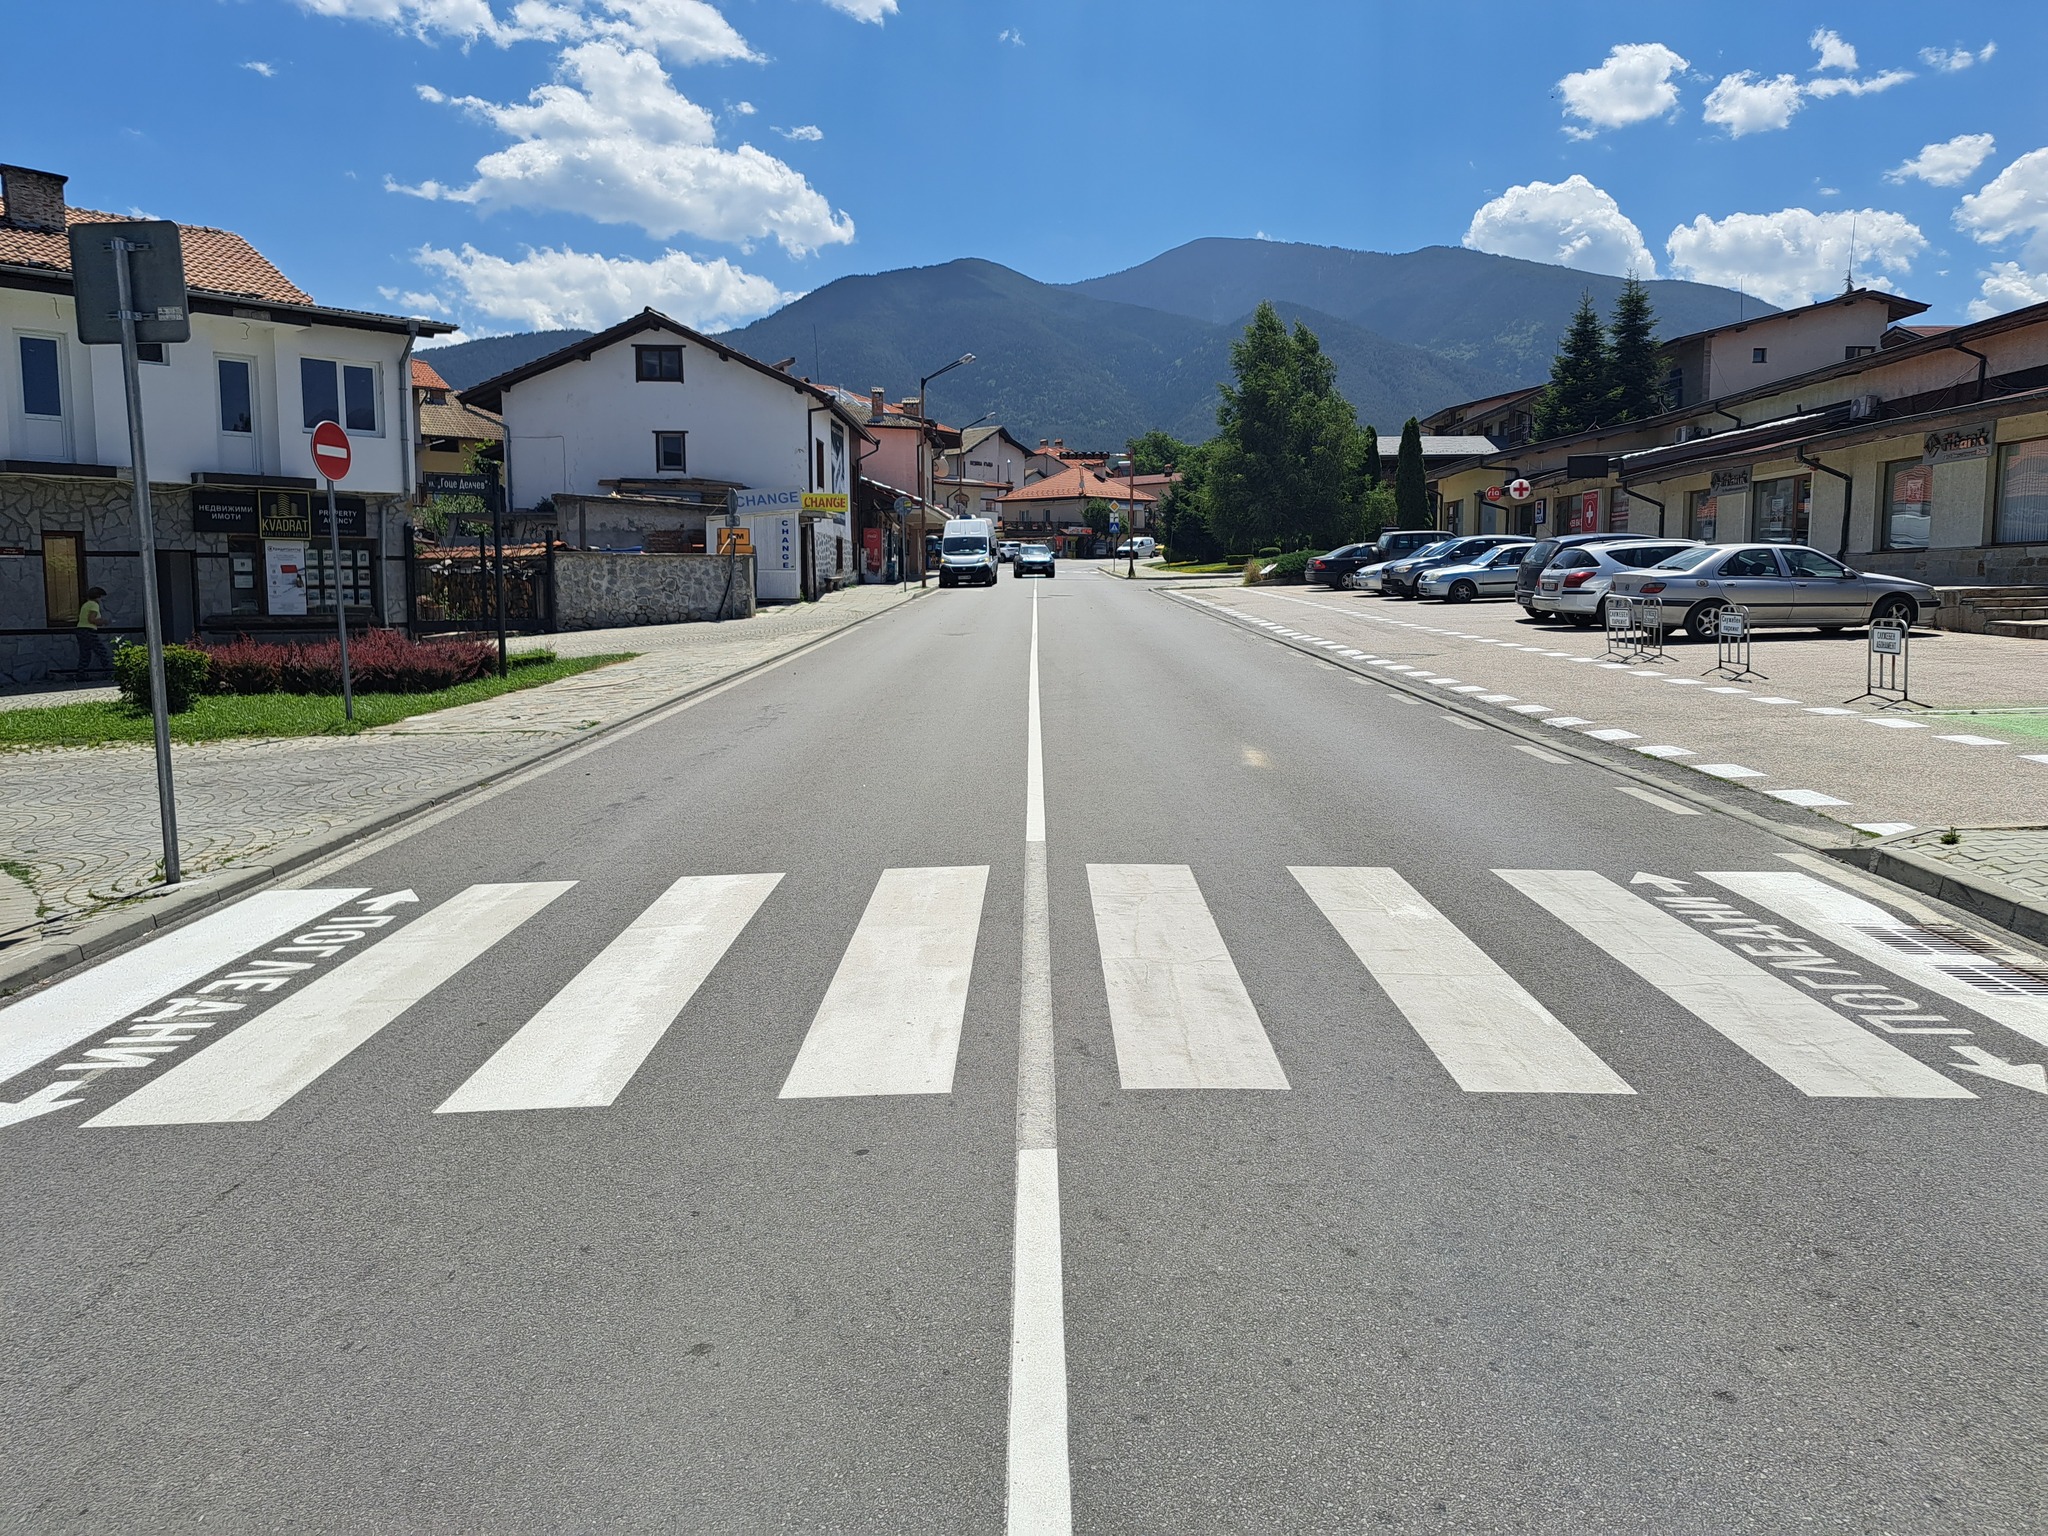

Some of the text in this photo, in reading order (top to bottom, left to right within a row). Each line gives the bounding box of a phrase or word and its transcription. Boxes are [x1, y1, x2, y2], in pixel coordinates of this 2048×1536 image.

[736, 491, 799, 508] CHANGE
[804, 496, 846, 508] CHANGE
[198, 504, 254, 513] НЕДВИЖИМИ
[318, 509, 358, 517] PRPERTY
[211, 513, 242, 521] ИМОТИ
[262, 518, 309, 532] KVADRAT
[781, 520, 790, 569] CHANGE
[1654, 896, 1975, 1035] ПОГЛЕДНИ
[55, 915, 396, 1071] ПОГЛЕДНИ
